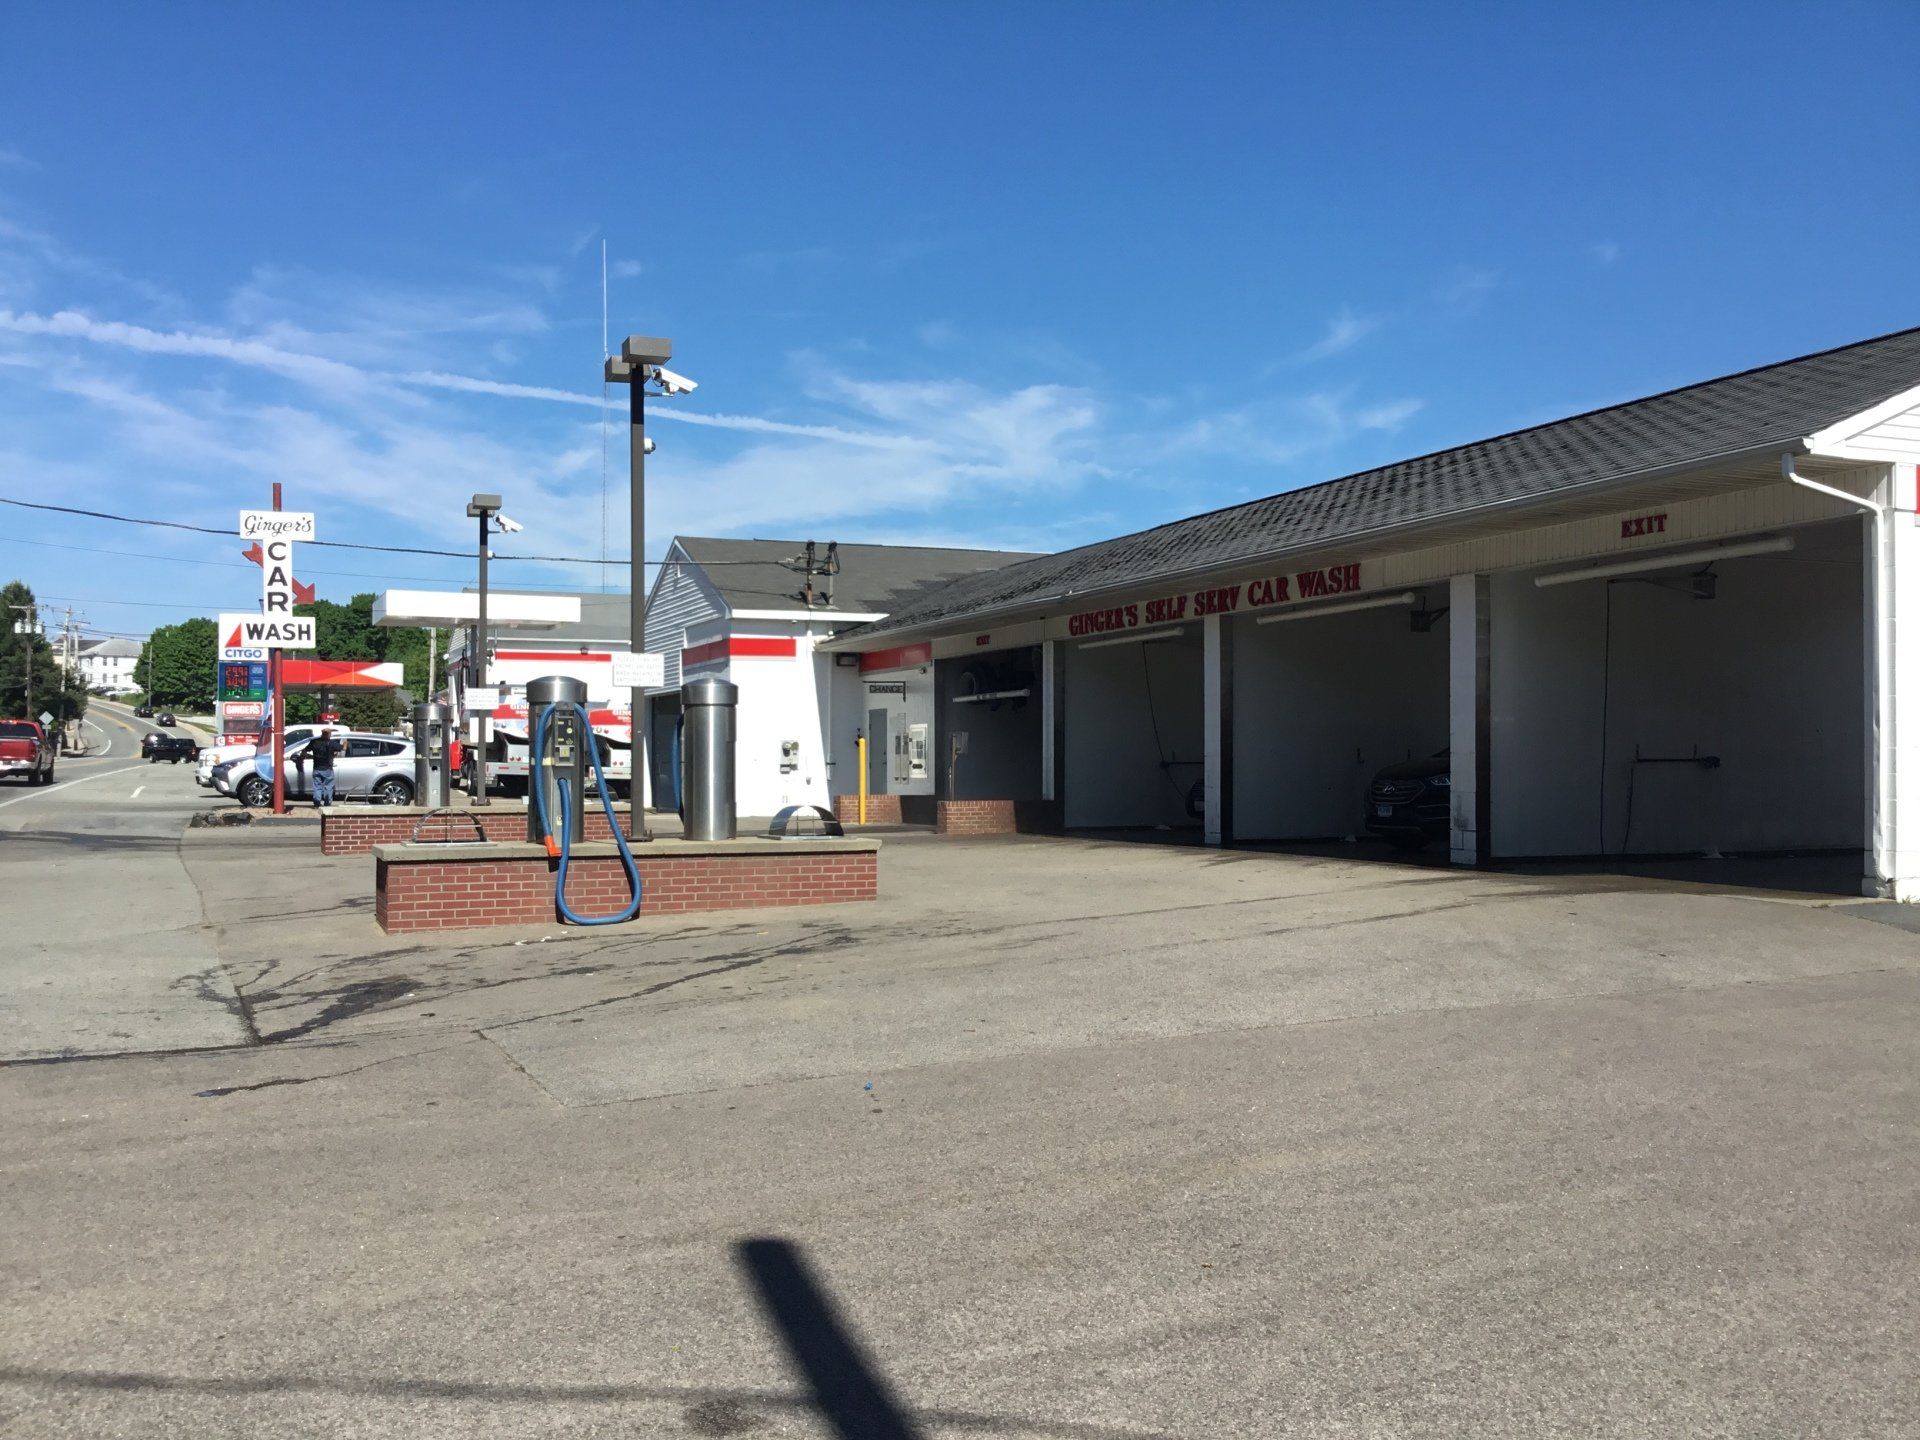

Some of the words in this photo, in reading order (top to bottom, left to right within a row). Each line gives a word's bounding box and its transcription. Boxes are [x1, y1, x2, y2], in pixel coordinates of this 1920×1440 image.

[244, 515, 312, 537] Ginger's
[1621, 515, 1667, 538] EXIT
[267, 542, 289, 613] CAR
[1069, 605, 1138, 637] GINGER'S
[1145, 597, 1187, 622] SELF
[1194, 586, 1241, 616] SERV
[1247, 577, 1289, 606] CAR
[1296, 564, 1361, 598] WASH
[246, 622, 312, 642] WASH
[225, 649, 262, 659] CITGO
